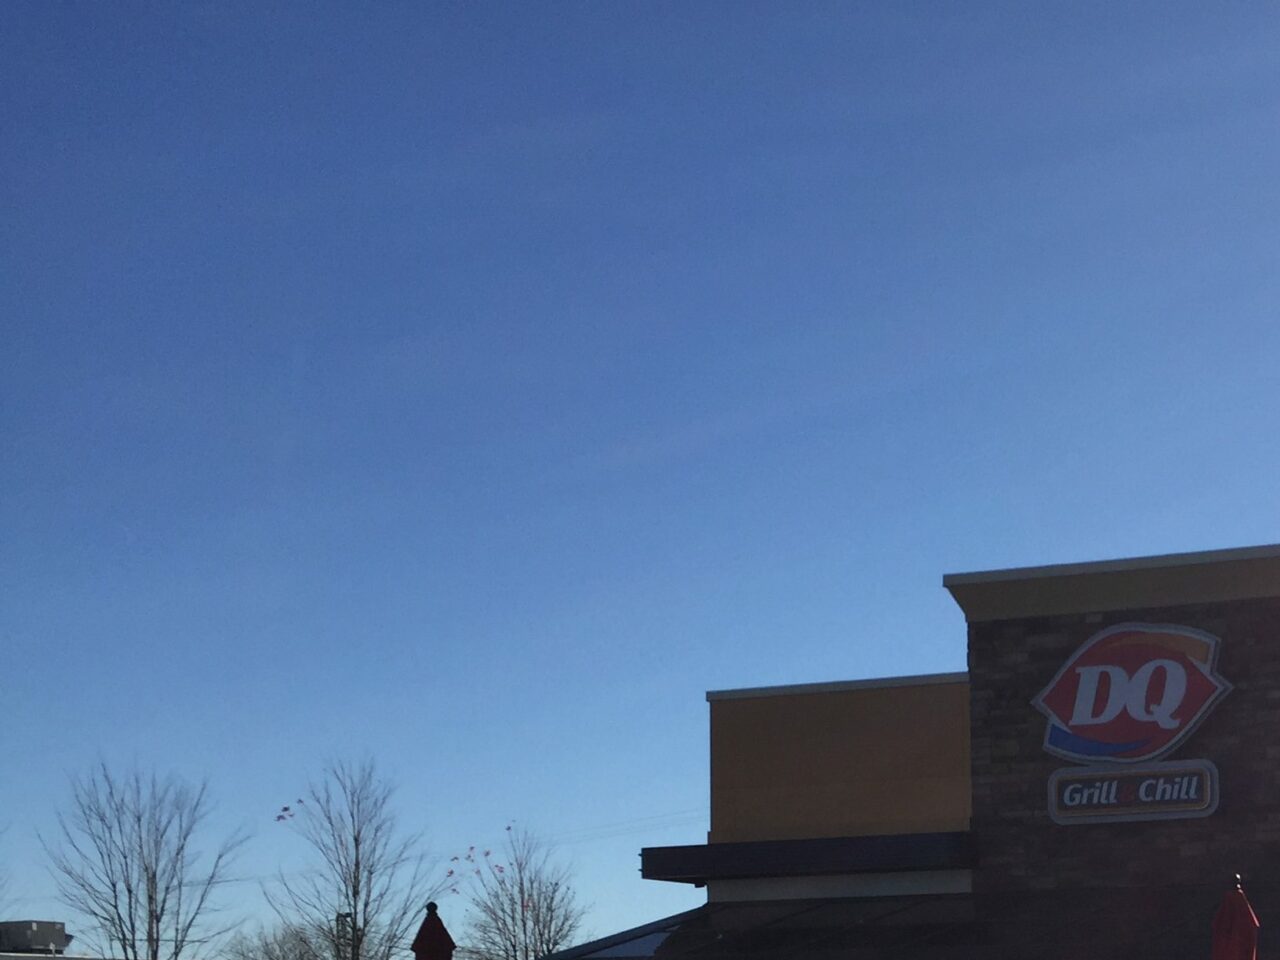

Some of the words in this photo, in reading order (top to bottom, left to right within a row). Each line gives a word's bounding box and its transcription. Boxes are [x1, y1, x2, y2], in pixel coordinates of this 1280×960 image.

[1068, 659, 1187, 730] DQ
[1063, 780, 1119, 806] Grill
[1138, 776, 1199, 802] Chill
